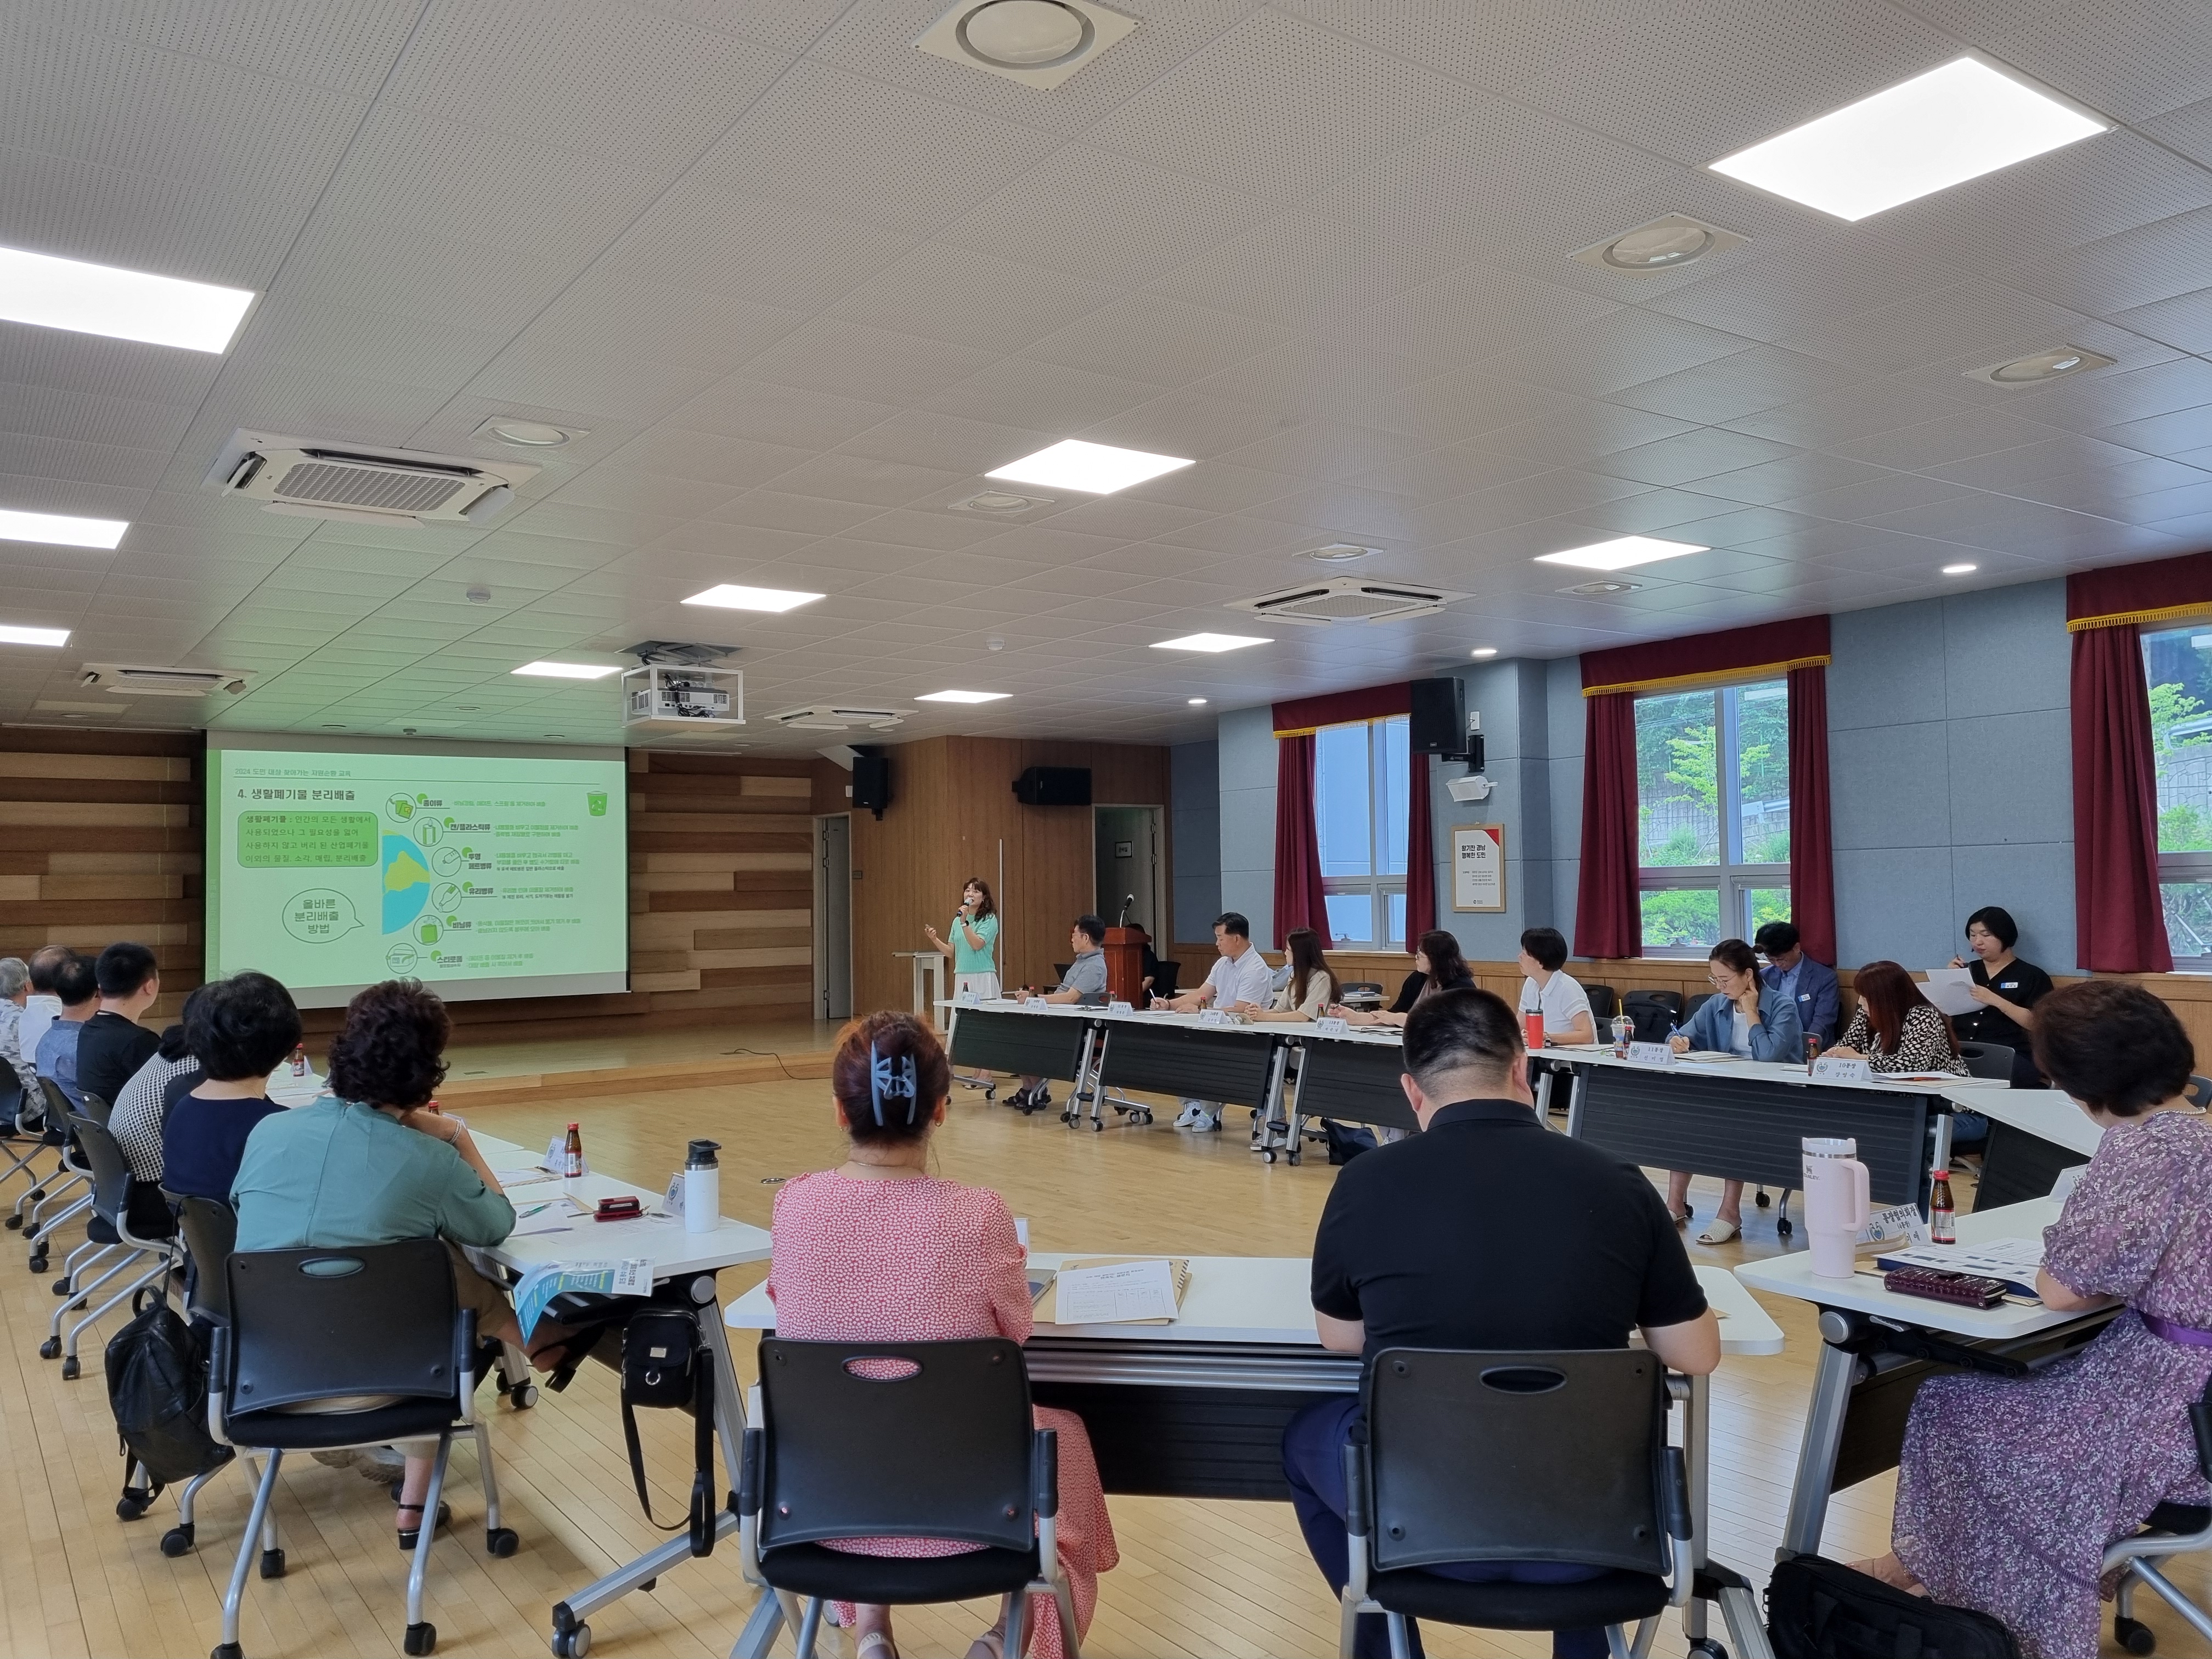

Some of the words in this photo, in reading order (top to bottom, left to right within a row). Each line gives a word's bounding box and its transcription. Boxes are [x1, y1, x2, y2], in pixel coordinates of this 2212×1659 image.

[238, 789, 247, 799] 4.
[251, 789, 307, 800] 생활폐기물
[312, 789, 356, 800] 분리배출
[245, 855, 270, 863] 이외의
[336, 855, 367, 863] 분리배출
[302, 899, 336, 909] 올바른
[295, 911, 339, 922] 분리배출
[308, 924, 330, 934] 방법
[1882, 1205, 1917, 1224] 통장협의회장
